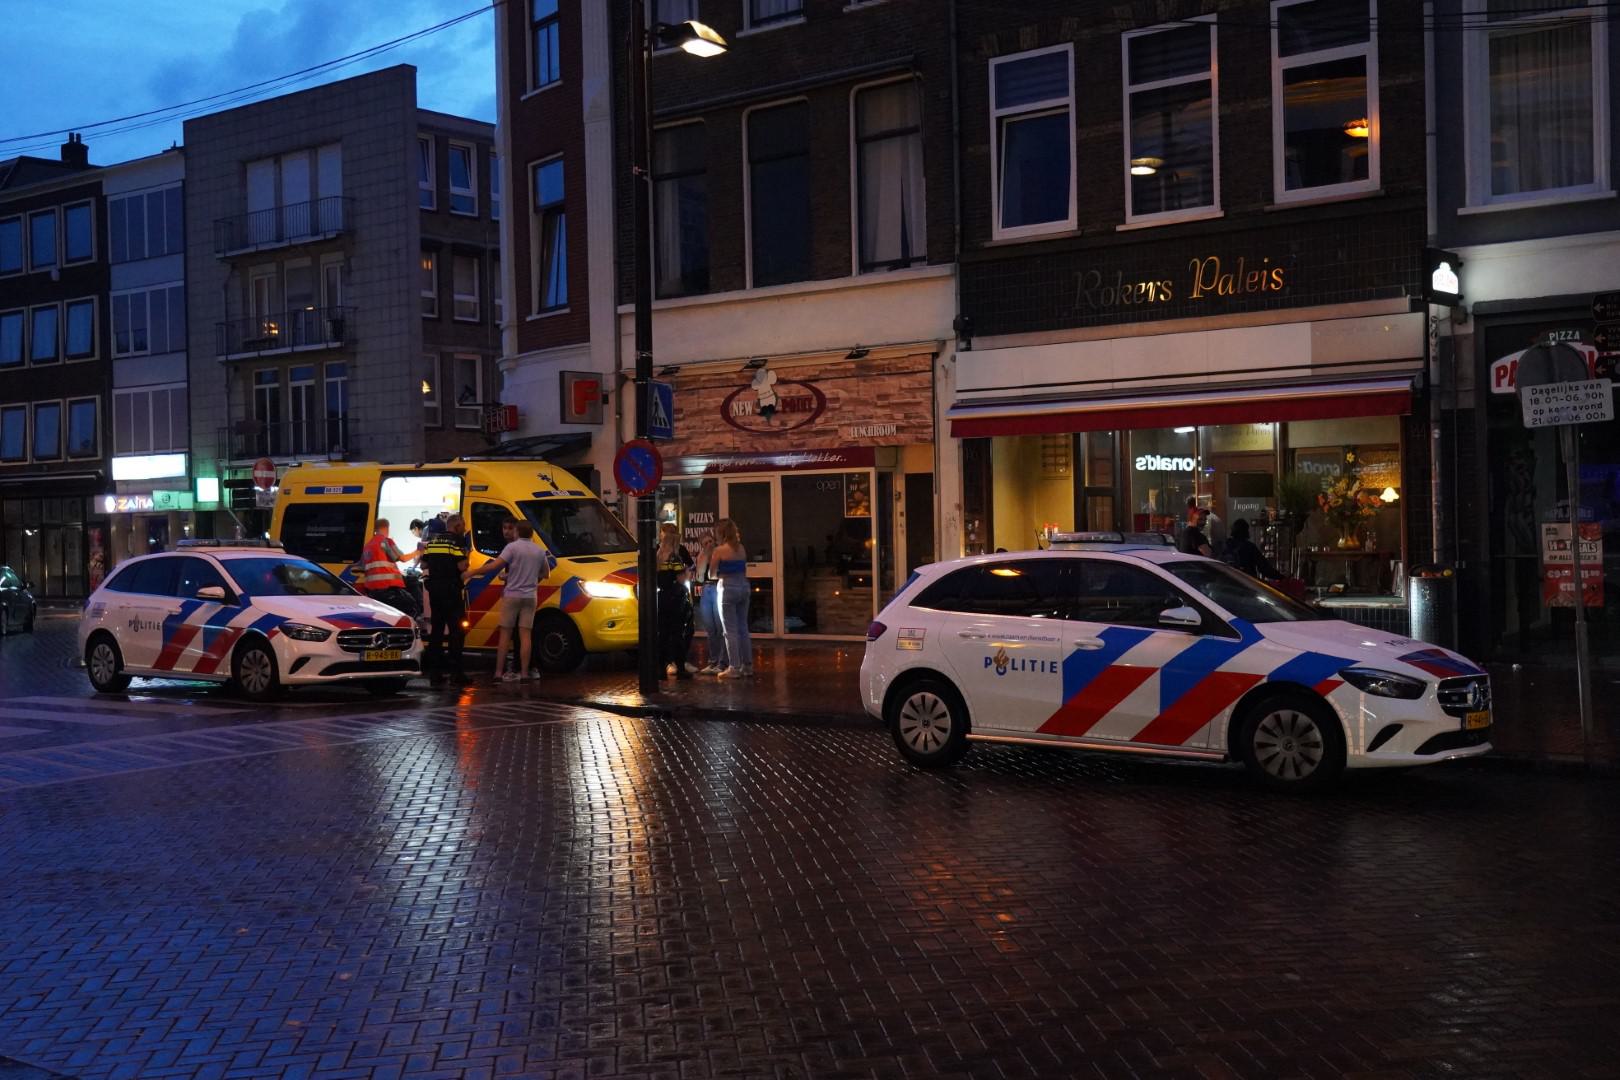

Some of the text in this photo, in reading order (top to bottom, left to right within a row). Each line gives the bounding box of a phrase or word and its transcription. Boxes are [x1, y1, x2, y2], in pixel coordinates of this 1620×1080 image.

[1073, 255, 1284, 308] Rokers Paleis
[1549, 331, 1580, 341] PIZZA
[1531, 384, 1580, 395] Dagelijks
[732, 401, 754, 416] NEW
[850, 424, 897, 438] LUNCHROOM
[688, 512, 714, 524] PIZZA'S
[1578, 543, 1597, 553] EALS
[129, 616, 161, 632] POLITIE
[984, 650, 1058, 675] POLITIE
